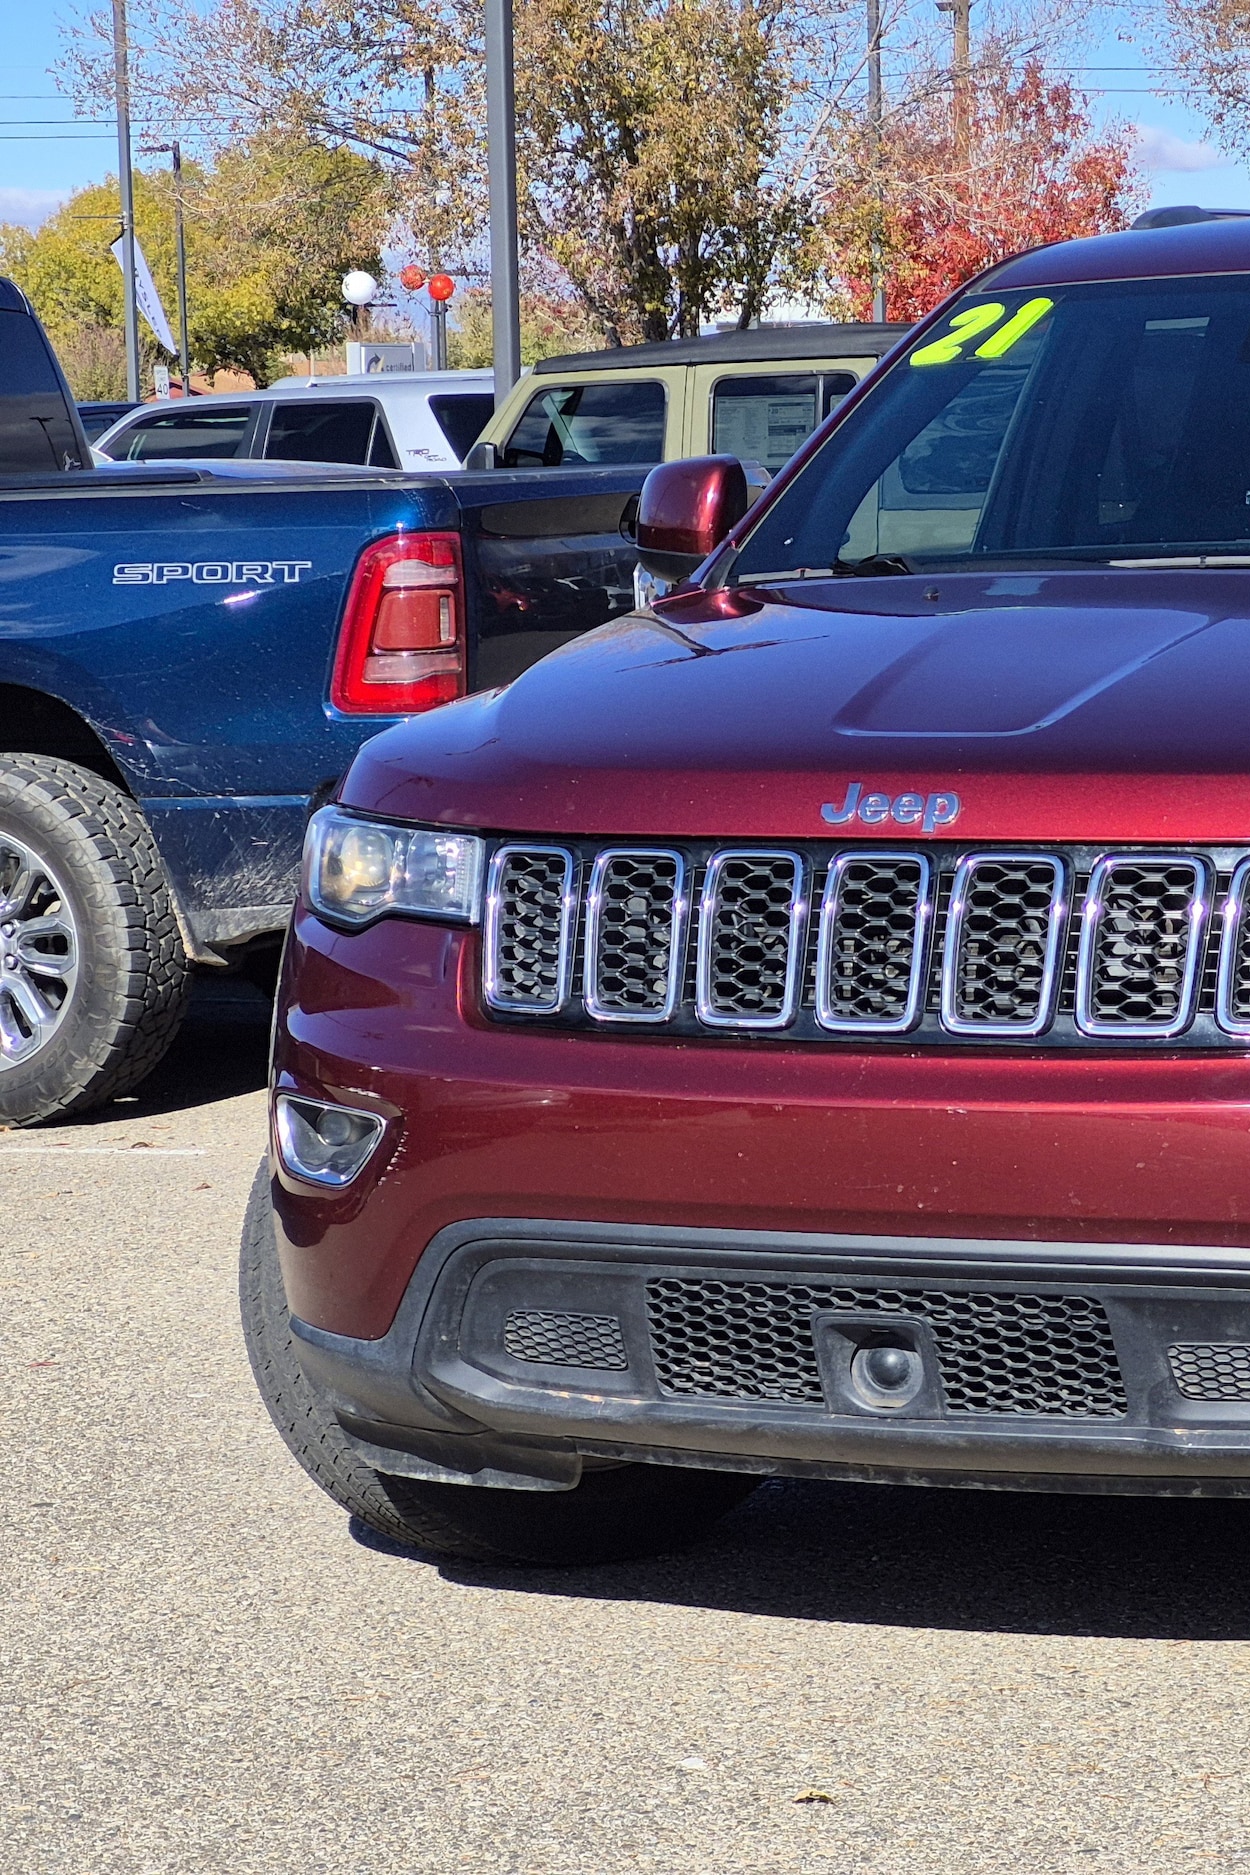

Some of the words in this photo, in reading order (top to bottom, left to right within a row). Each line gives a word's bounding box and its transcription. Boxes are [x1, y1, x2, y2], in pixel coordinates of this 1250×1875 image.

[909, 297, 1054, 367] 21
[157, 383, 169, 396] 40
[112, 561, 312, 585] SPORT
[821, 782, 961, 833] Jeep
